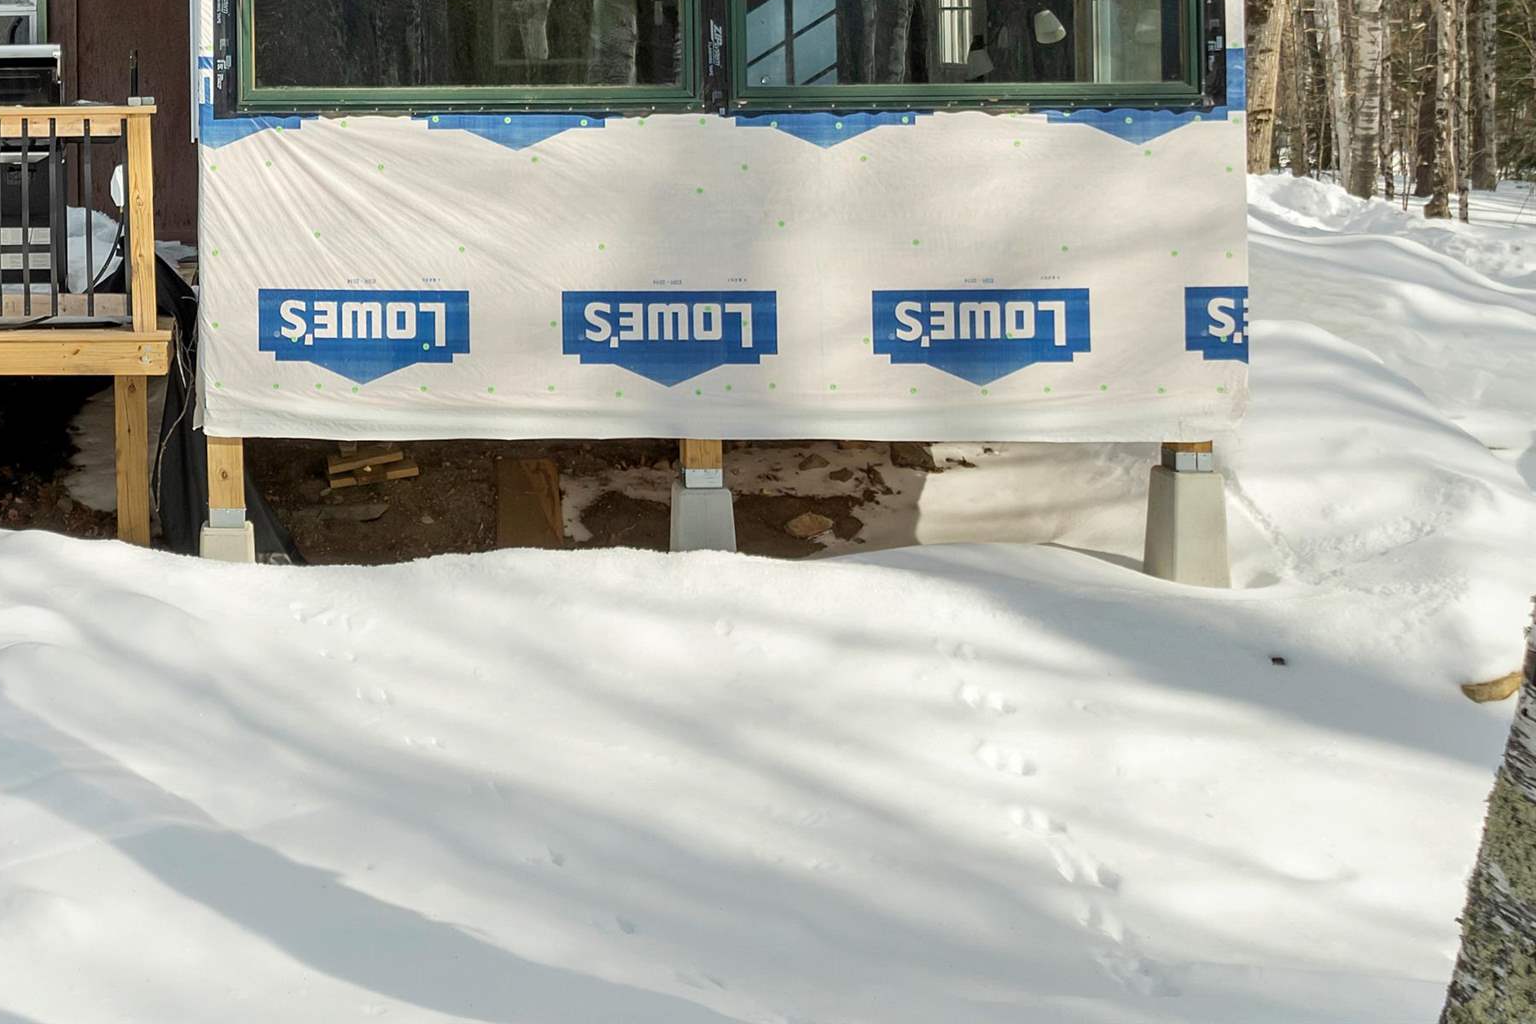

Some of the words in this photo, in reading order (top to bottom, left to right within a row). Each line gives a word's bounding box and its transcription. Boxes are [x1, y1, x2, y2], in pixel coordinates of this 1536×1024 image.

[279, 299, 447, 347] LOWE'S
[583, 301, 752, 348] LOWE'S
[894, 300, 1067, 347] LOWE'S
